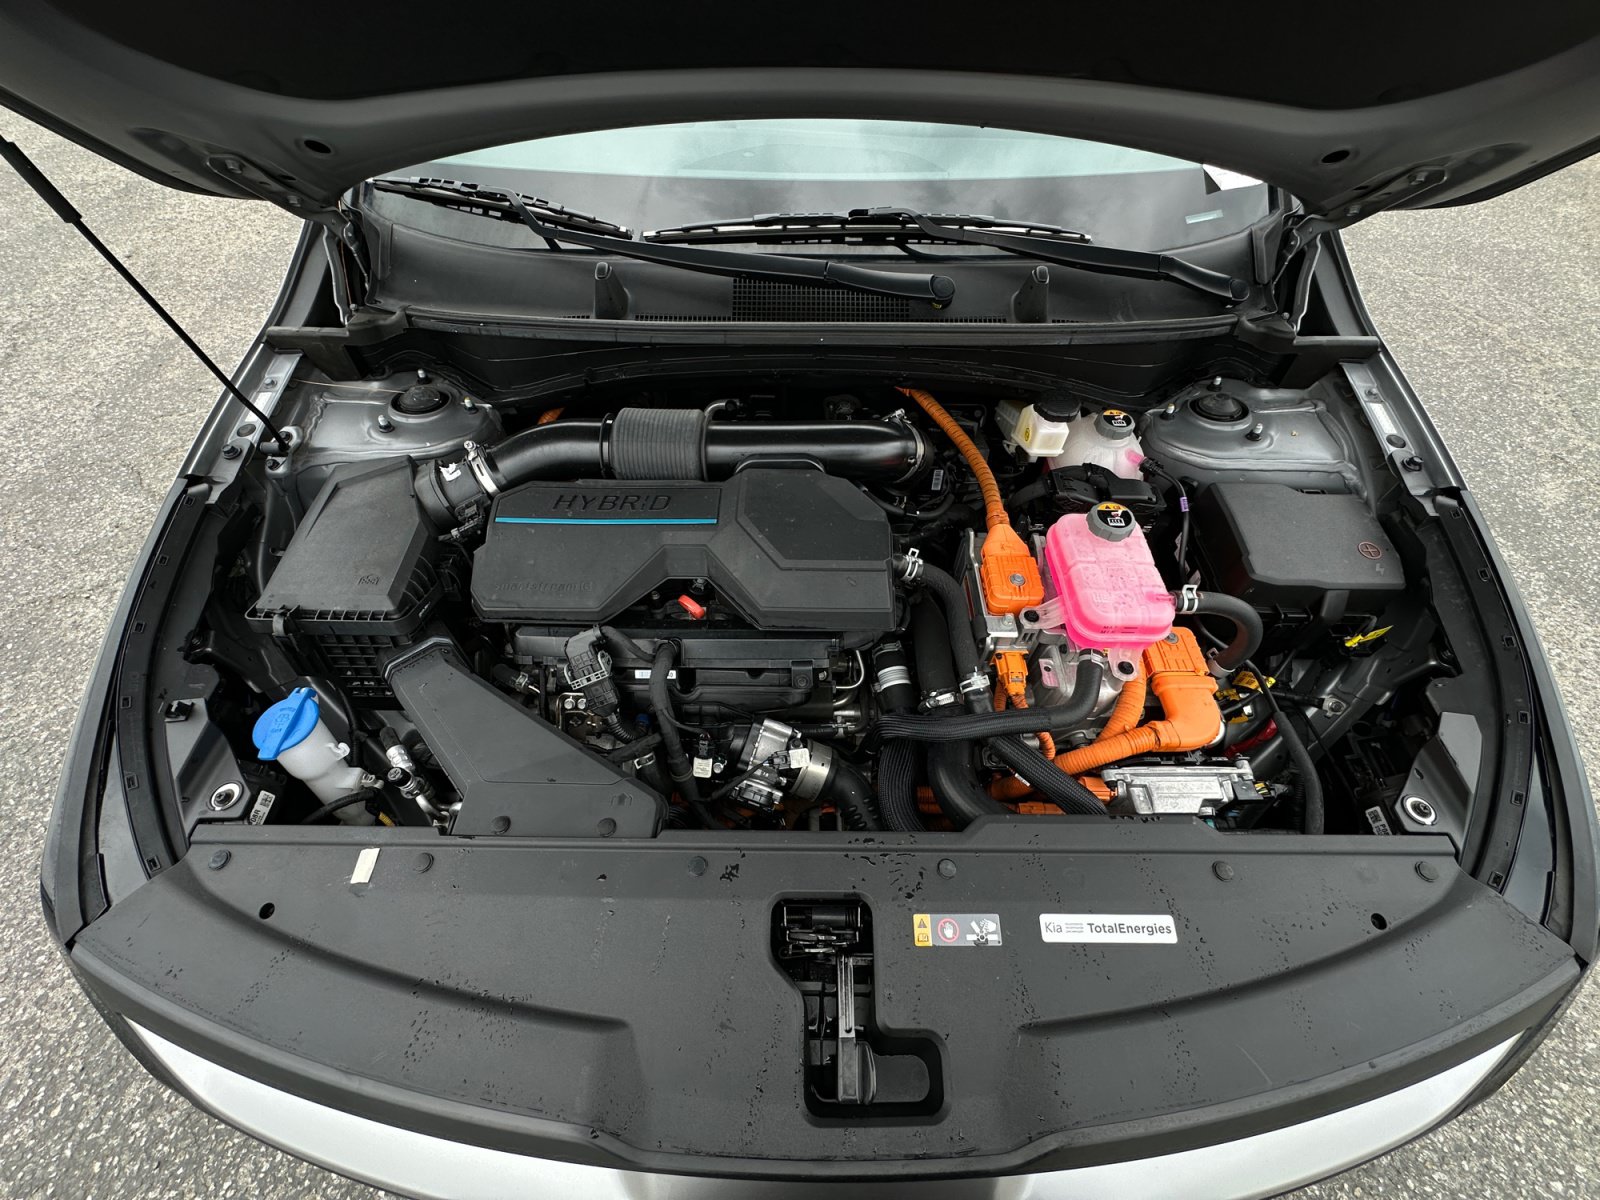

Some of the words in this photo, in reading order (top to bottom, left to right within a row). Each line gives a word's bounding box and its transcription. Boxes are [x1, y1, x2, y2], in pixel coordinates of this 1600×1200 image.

[552, 494, 671, 512] HYBRID
[1044, 921, 1063, 934] Kia
[1086, 922, 1172, 936] TotalEnergies
